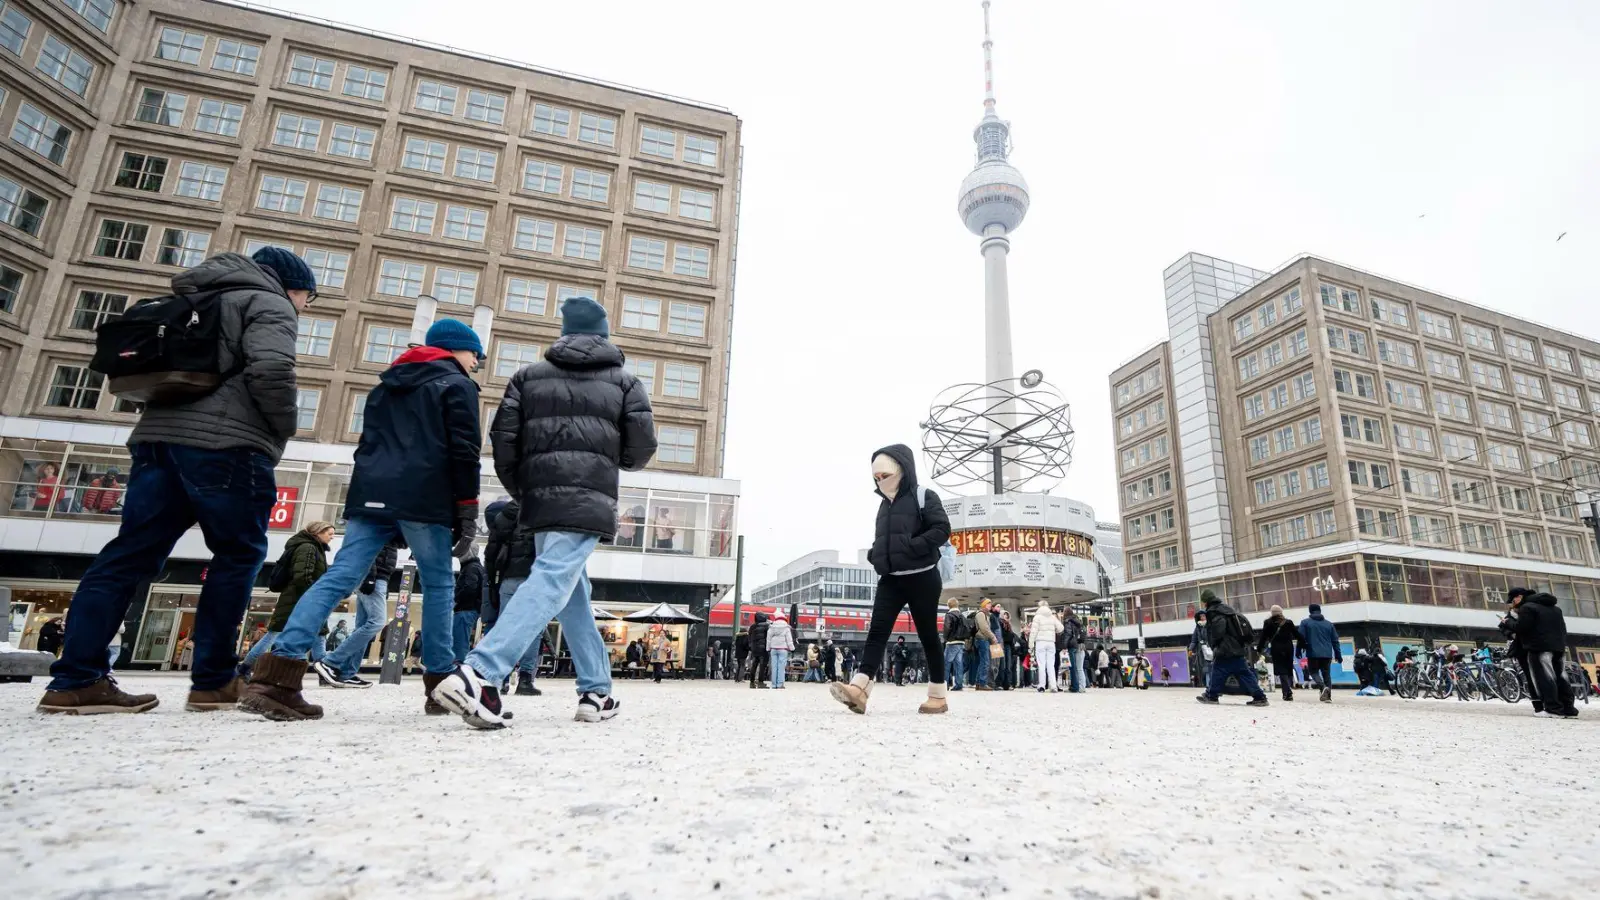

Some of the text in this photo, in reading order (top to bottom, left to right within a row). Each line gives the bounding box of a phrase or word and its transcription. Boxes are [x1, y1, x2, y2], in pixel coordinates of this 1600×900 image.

[966, 533, 985, 548] 14
[991, 532, 1011, 547] 15
[1018, 532, 1037, 547] 16
[1042, 533, 1059, 548] 17
[1063, 536, 1076, 552] 18
